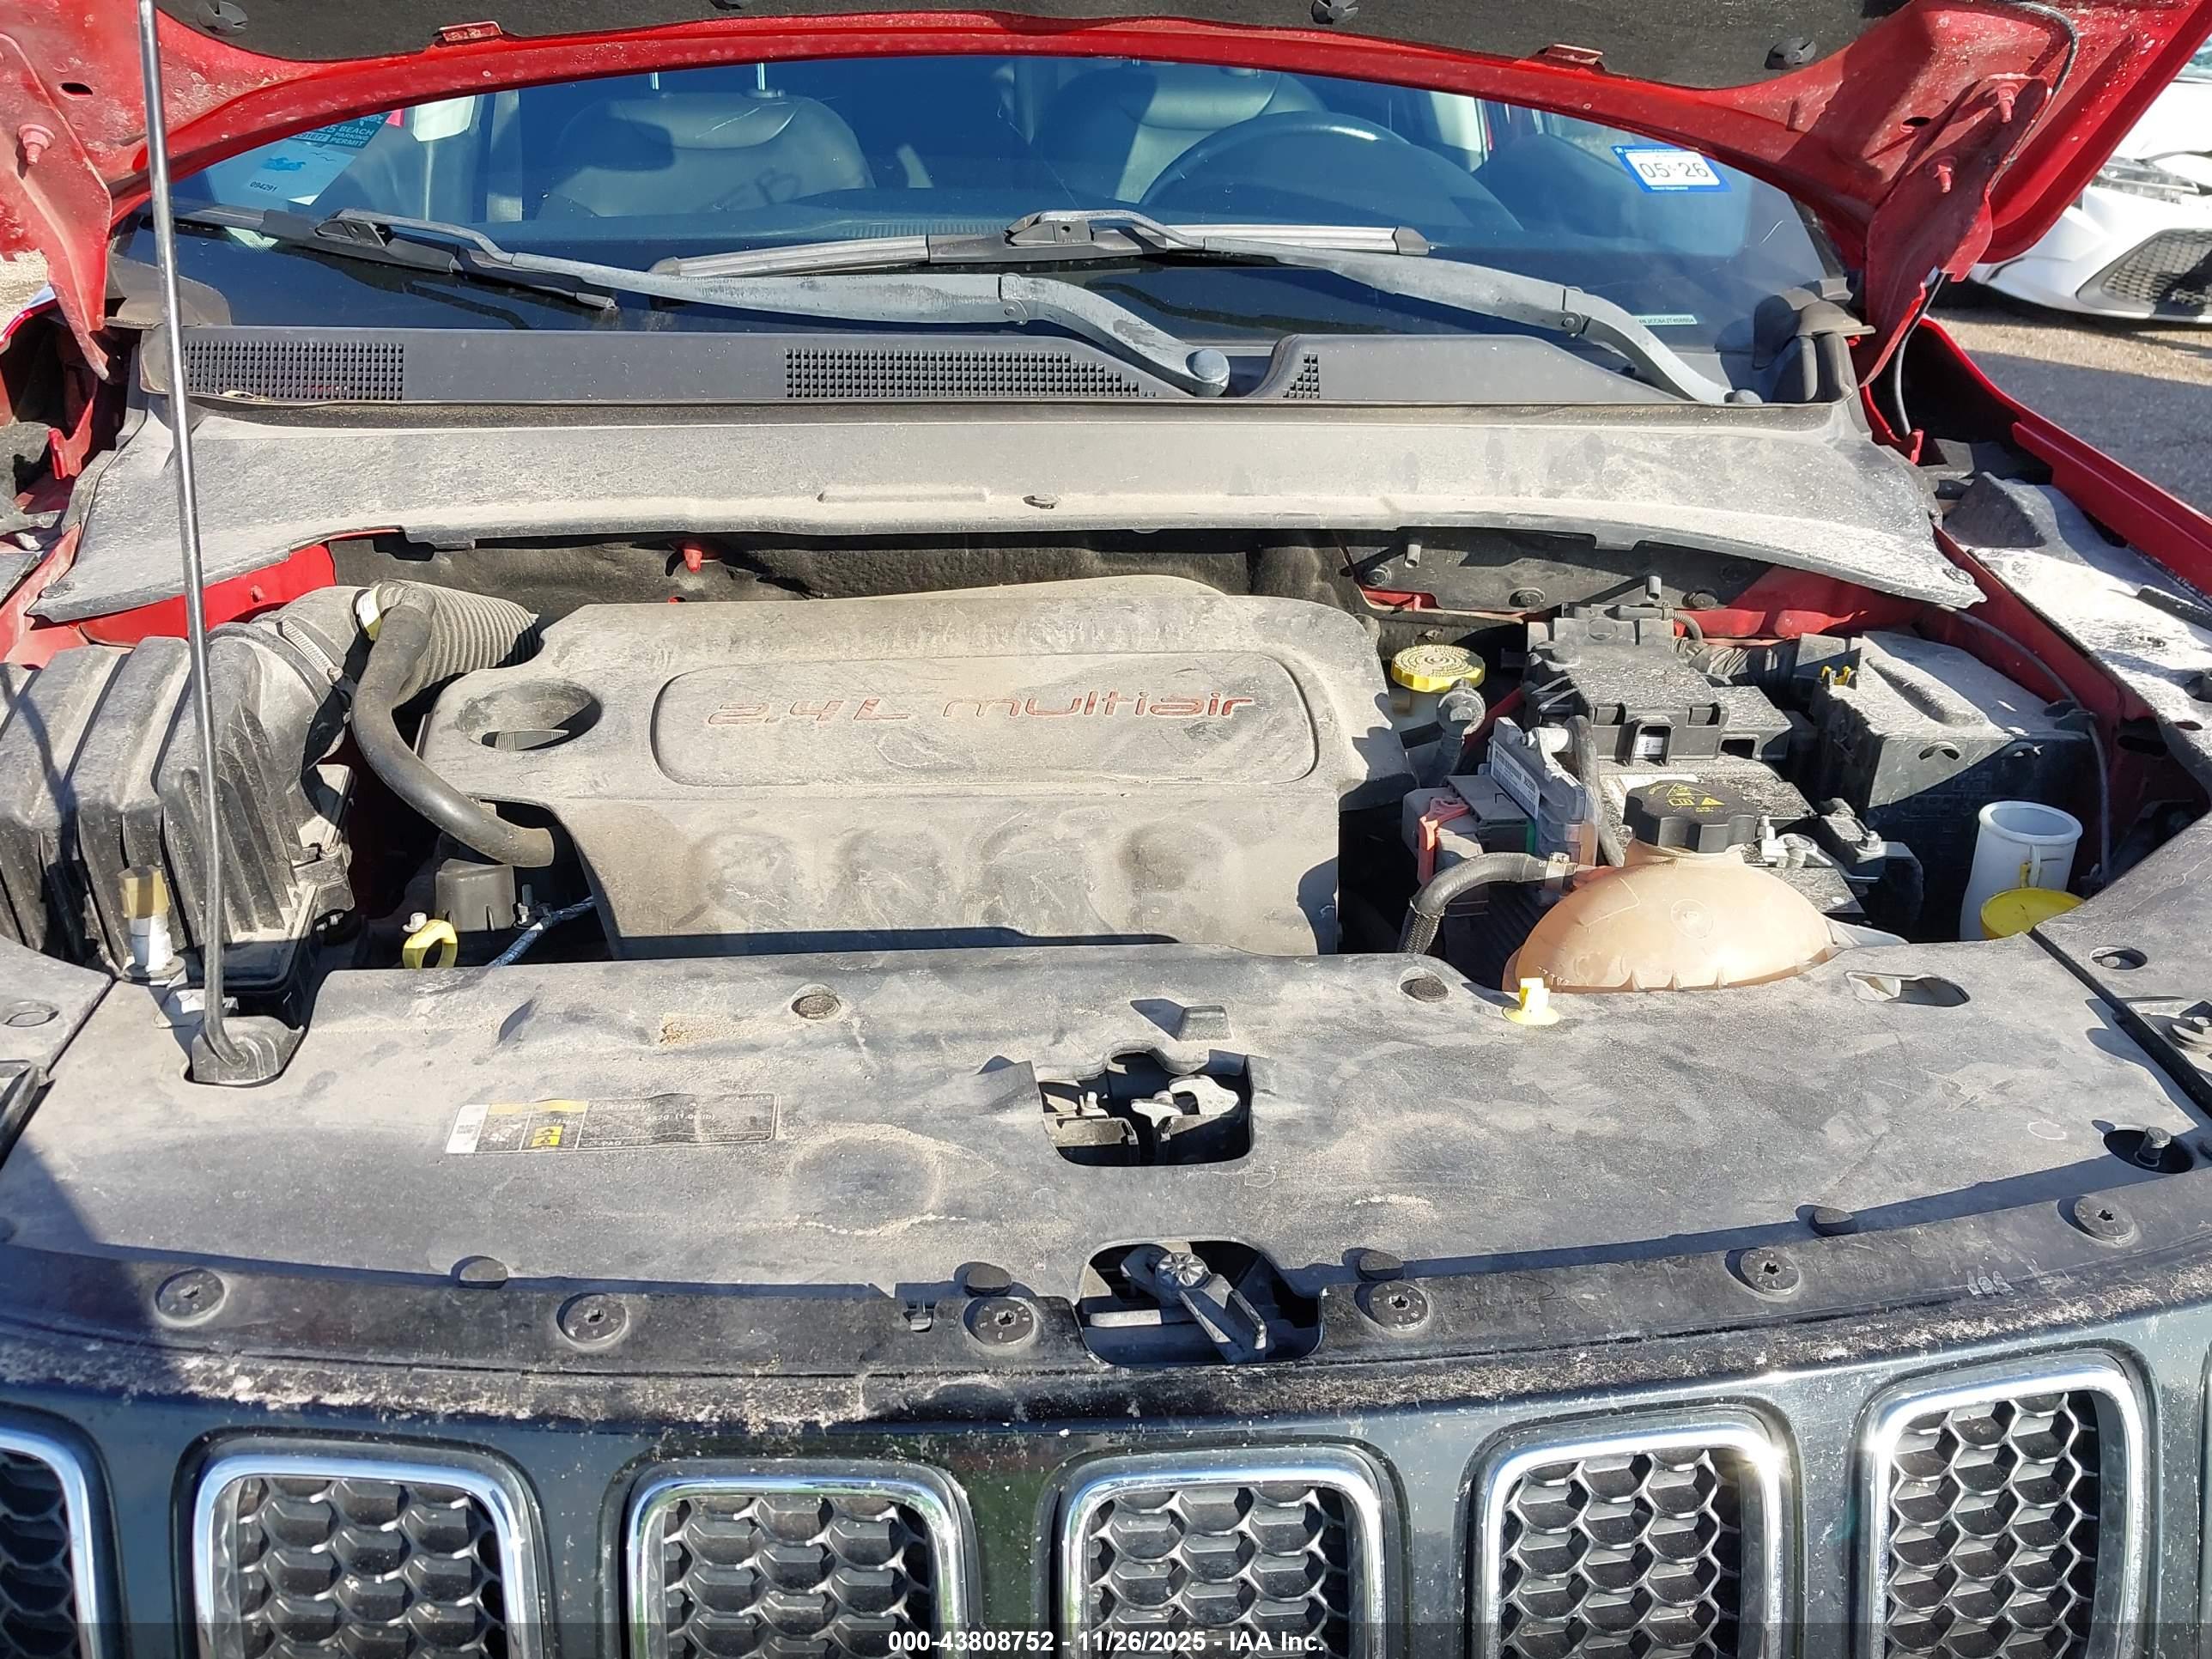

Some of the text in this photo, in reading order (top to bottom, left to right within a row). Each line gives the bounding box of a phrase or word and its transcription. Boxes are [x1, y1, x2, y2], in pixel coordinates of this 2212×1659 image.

[333, 131, 370, 141] PARKING
[339, 125, 374, 136] BEACH
[330, 137, 367, 148] PERMIT
[249, 180, 278, 192] 094291
[942, 690, 1253, 718] multiair
